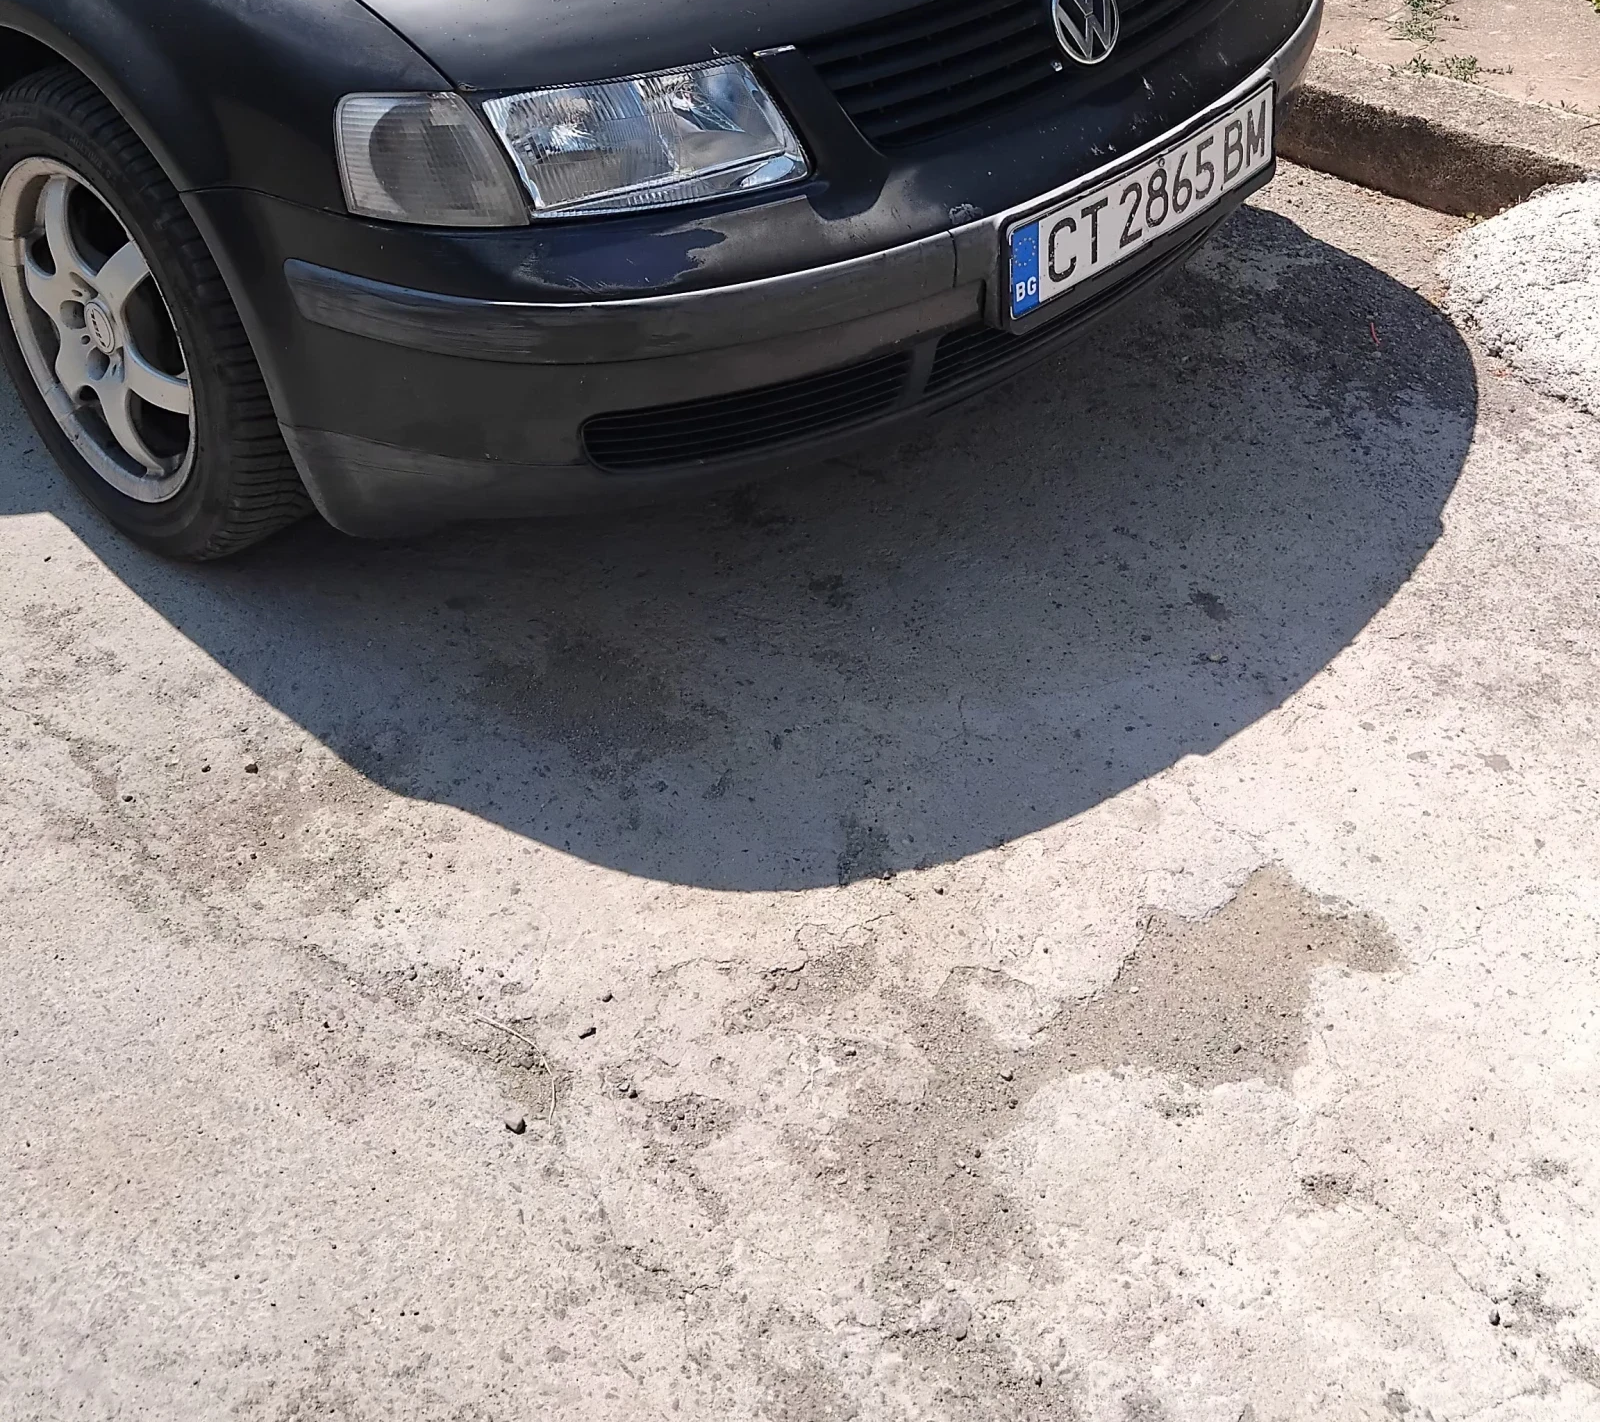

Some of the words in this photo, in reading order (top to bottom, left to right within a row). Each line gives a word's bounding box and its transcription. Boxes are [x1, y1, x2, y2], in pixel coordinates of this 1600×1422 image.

[1048, 197, 1109, 283] CT
[1119, 135, 1215, 249] 2865
[1223, 99, 1266, 185] BM
[1015, 276, 1037, 303] BG
